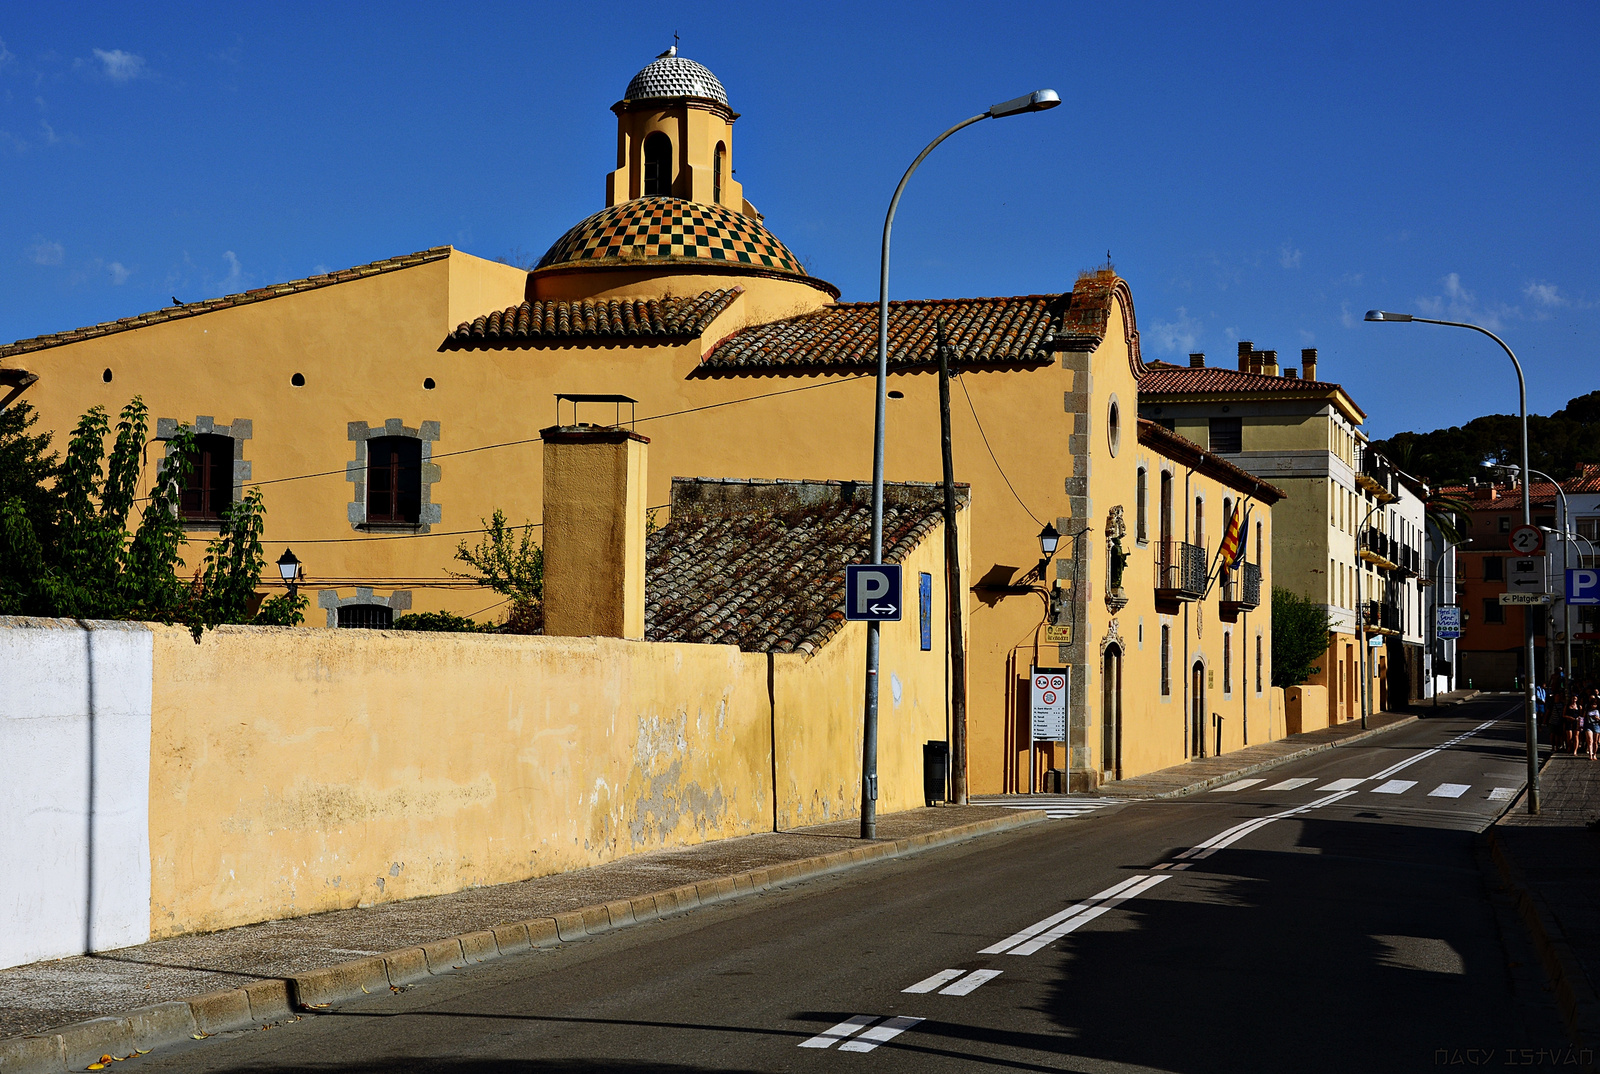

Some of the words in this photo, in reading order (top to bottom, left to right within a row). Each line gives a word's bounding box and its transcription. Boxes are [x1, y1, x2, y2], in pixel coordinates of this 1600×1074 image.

[857, 571, 889, 613] P
[1572, 570, 1598, 597] P
[1512, 595, 1539, 604] Platges
